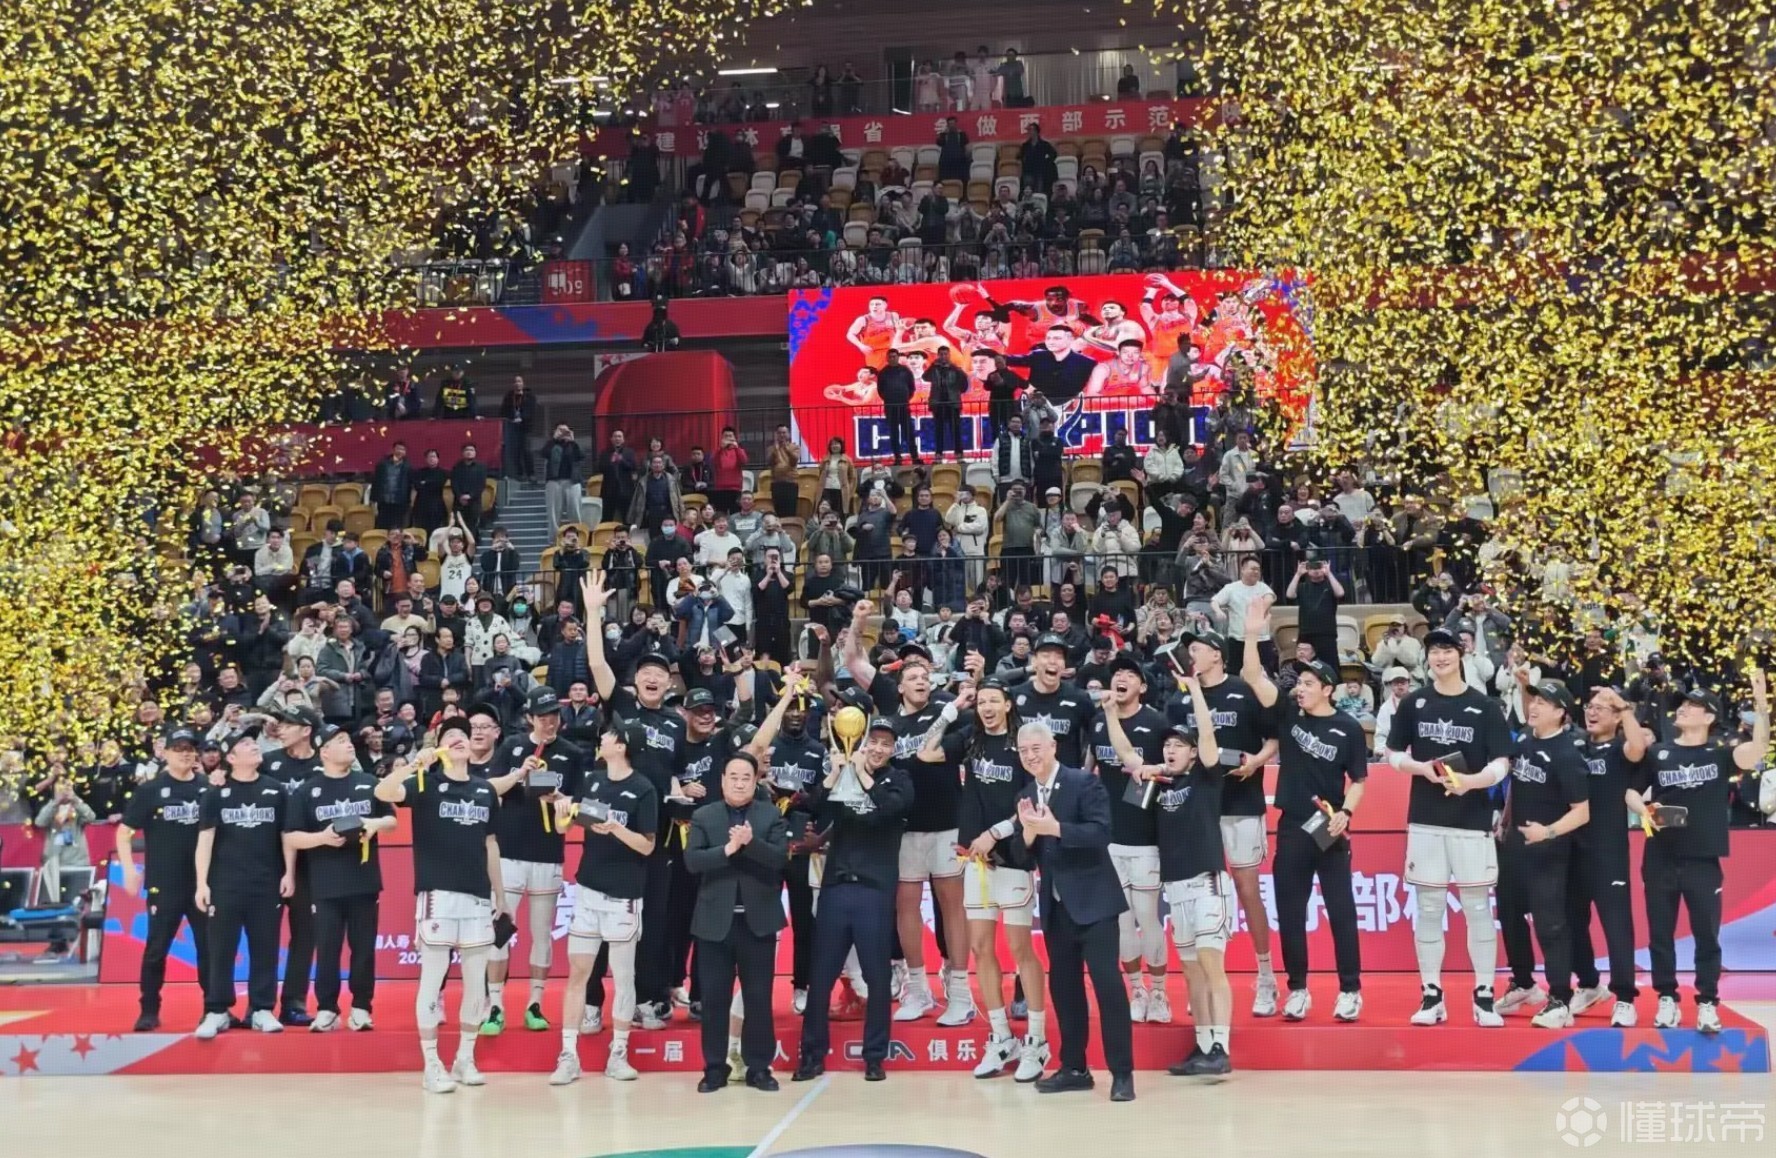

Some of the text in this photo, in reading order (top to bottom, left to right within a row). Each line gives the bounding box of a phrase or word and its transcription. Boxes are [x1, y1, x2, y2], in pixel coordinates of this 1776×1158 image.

[449, 570, 462, 580] 24
[1418, 721, 1475, 743] CHAMPIONS
[1658, 764, 1718, 788] CHAMPIONS
[221, 806, 275, 824] CHAMPIONS
[316, 799, 371, 821] CHAMPIONS
[439, 801, 490, 823] CHAMPIONS
